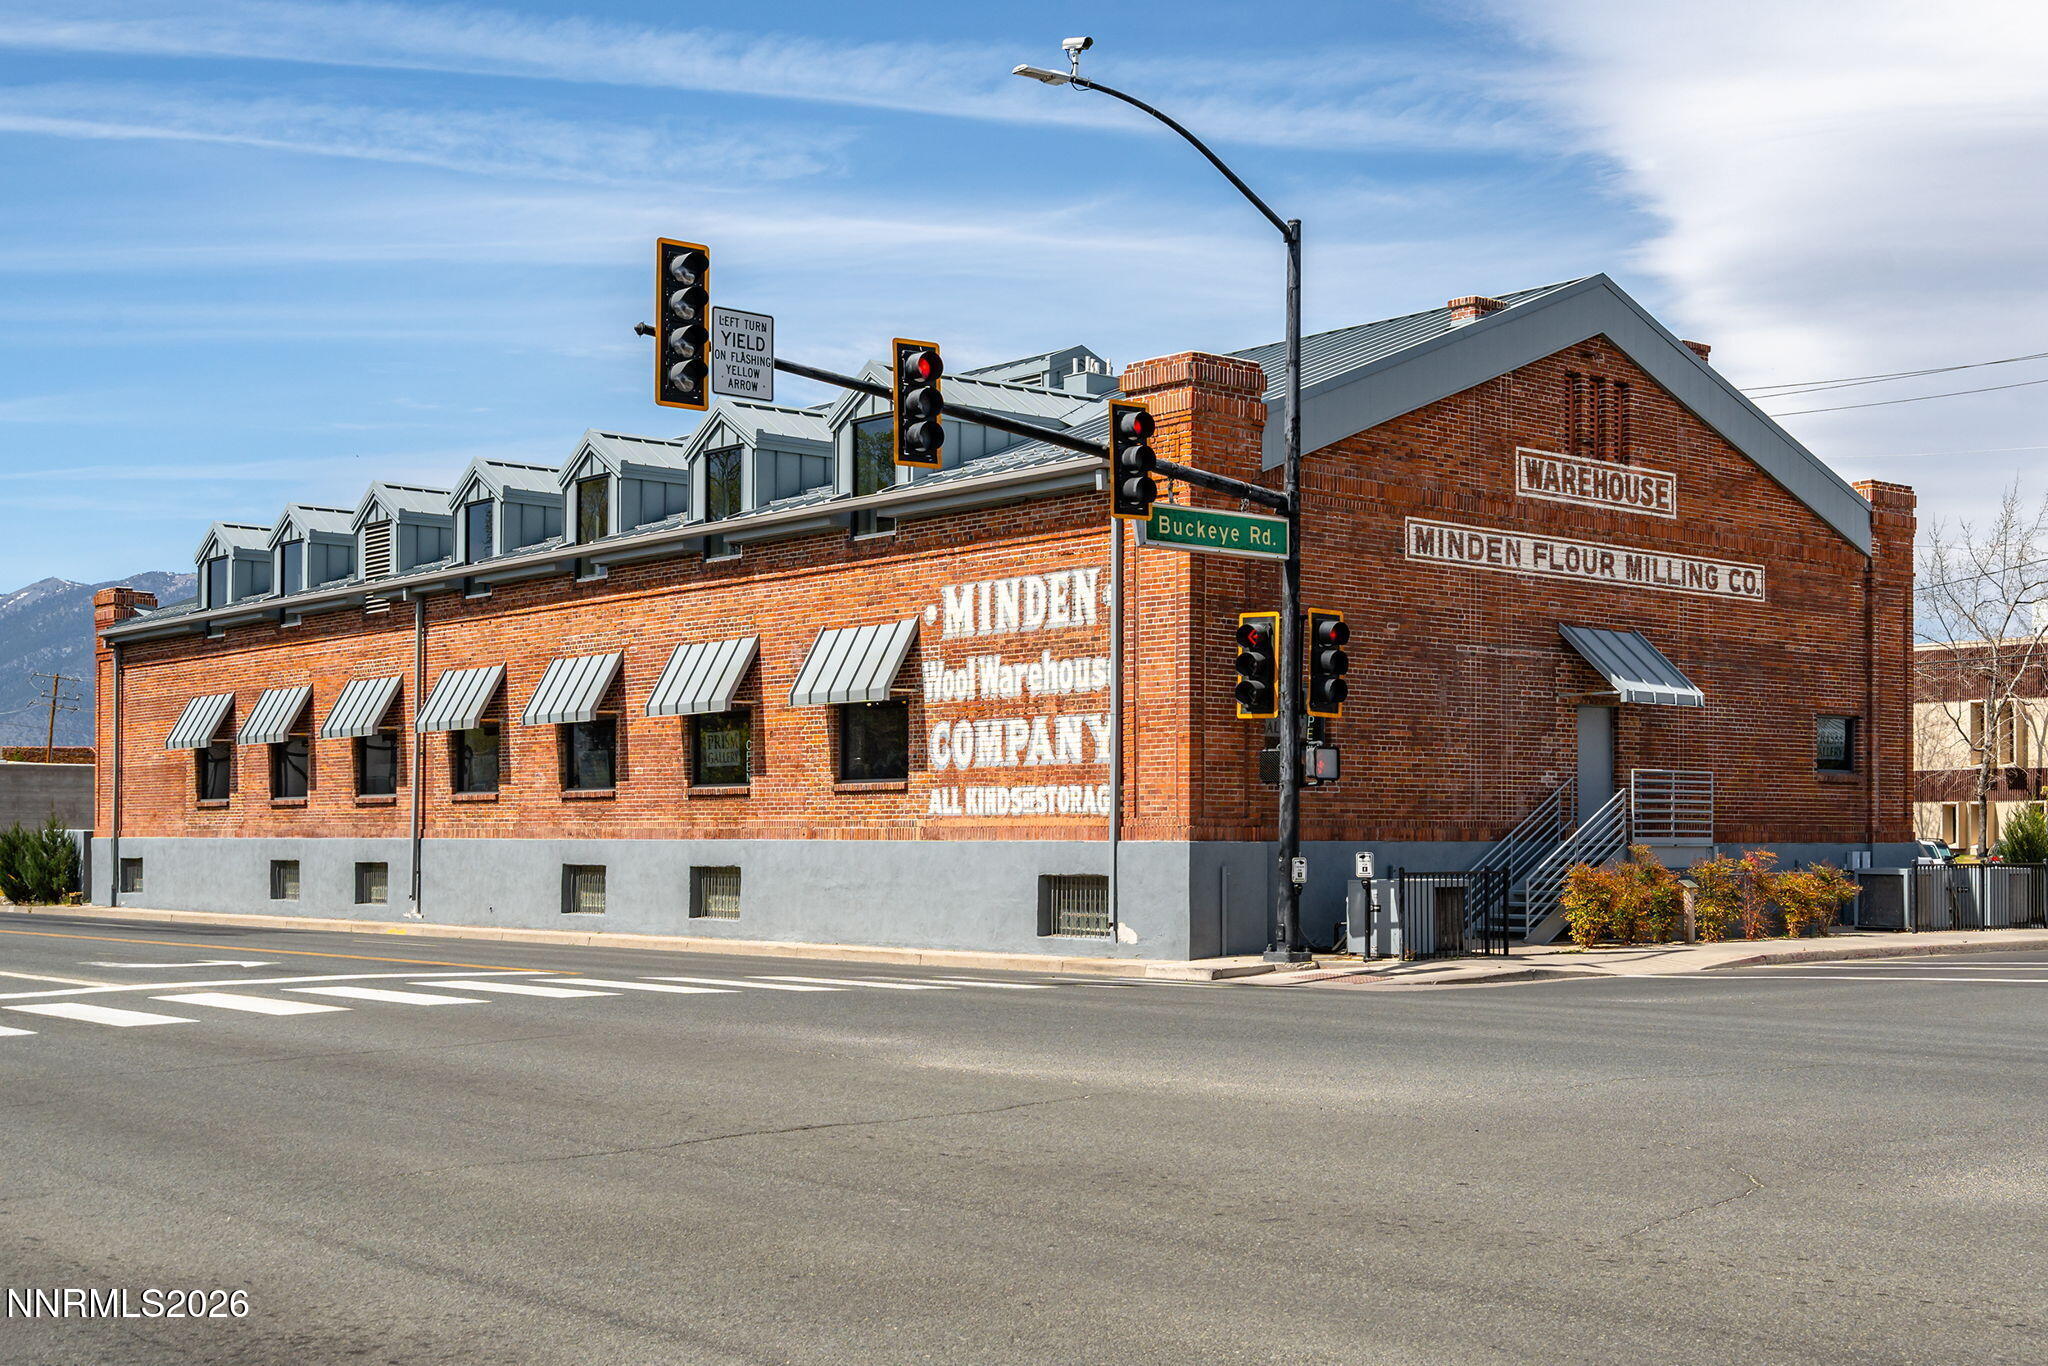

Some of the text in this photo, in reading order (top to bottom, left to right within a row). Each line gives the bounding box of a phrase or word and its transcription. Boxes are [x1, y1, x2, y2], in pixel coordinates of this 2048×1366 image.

[719, 315, 767, 332] LEFT TURN
[721, 330, 765, 352] YIELD
[715, 349, 771, 368] ON FLASHING
[726, 364, 760, 379] YELLOW
[728, 378, 758, 392] ARROW
[1525, 457, 1670, 509] WAREHOUSE
[1158, 515, 1277, 546] Buckeye Rd.
[1414, 526, 1760, 596] MINDEN FLOUR MILLING CO.
[941, 567, 1102, 641] MINDEN
[922, 650, 1112, 702] Wool Warehous
[708, 734, 739, 750] PRISM
[929, 713, 1112, 772] COMPANY
[1817, 746, 1842, 757] ALLERY
[928, 786, 962, 816] ALL
[965, 785, 1022, 816] KINDS
[1035, 784, 1111, 816] STORAG
